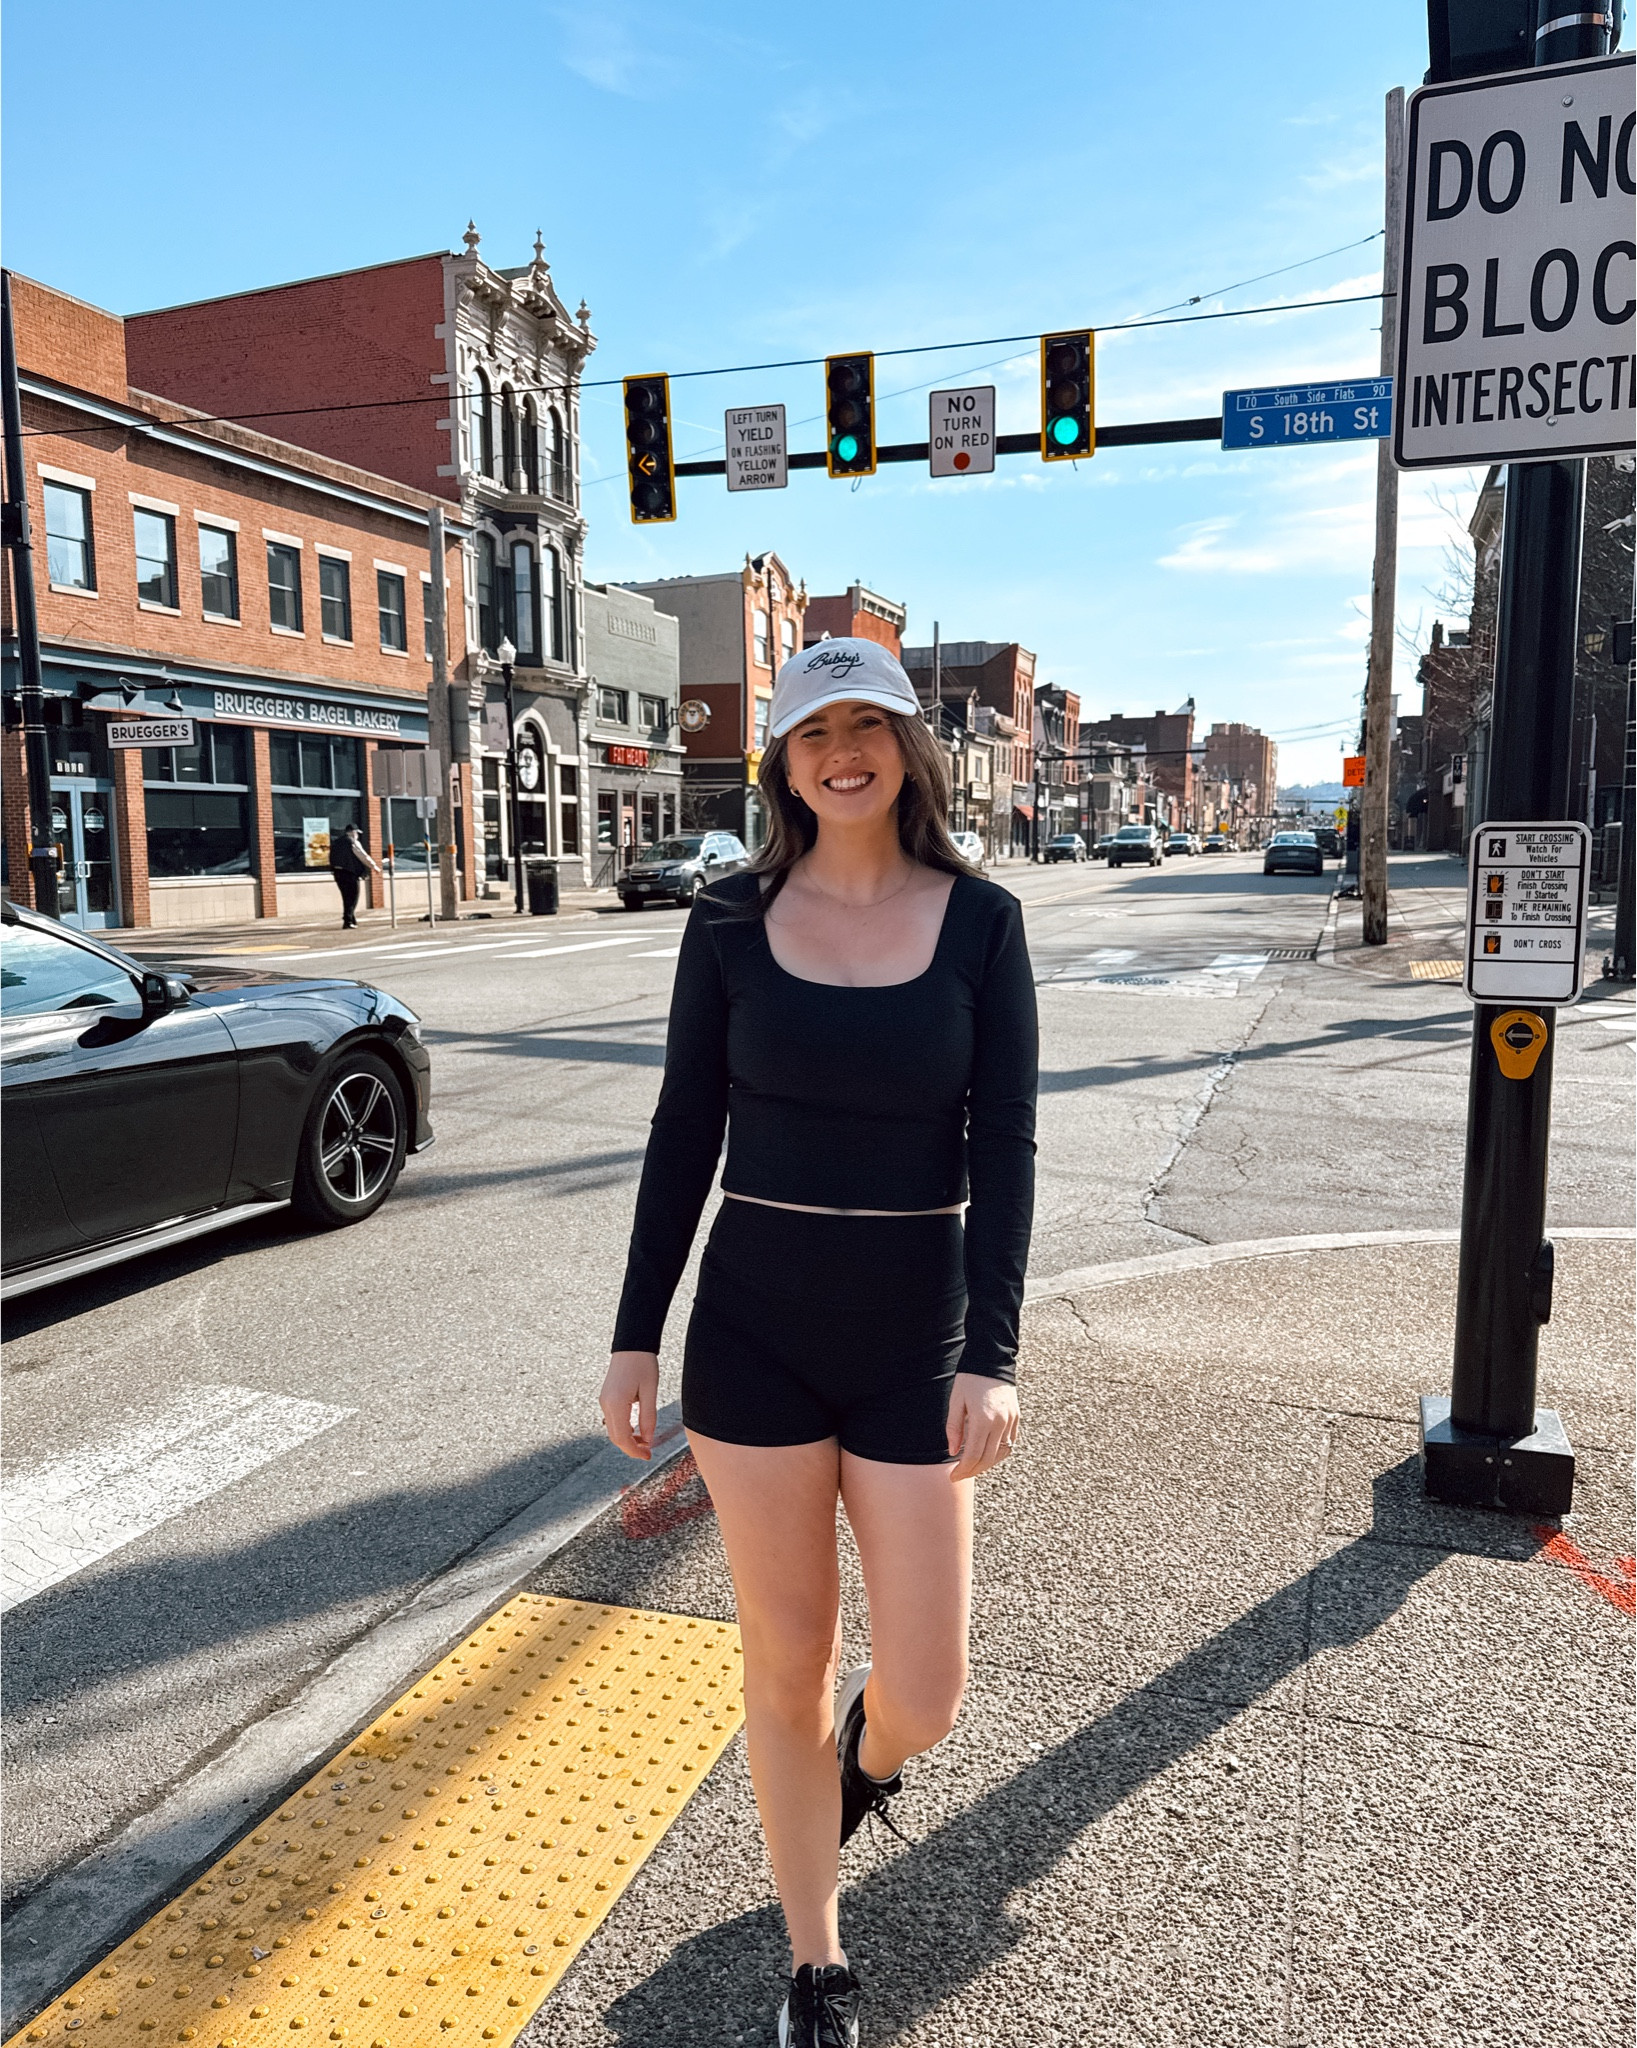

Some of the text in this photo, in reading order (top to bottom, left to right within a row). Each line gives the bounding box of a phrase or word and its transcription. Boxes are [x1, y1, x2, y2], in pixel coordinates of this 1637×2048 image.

[1427, 130, 1526, 222] DO
[1423, 240, 1636, 345] BLOC
[1245, 385, 1385, 408] 70 South Side Flats 90
[948, 395, 976, 413] NO
[732, 411, 778, 425] LEFT TURN
[943, 416, 981, 432] TURN
[1249, 406, 1379, 439] S 18th St
[738, 427, 774, 442] YIELD
[935, 433, 989, 450] ON RED
[731, 444, 782, 458] ON FLASHING
[737, 458, 777, 472] YELLOW
[739, 473, 776, 485] ARROW
[803, 652, 865, 679] Bubby's
[214, 691, 401, 731] BRUEGGER'S BAGEL BAKERY
[112, 724, 189, 739] BRUEGGER'S
[1516, 834, 1574, 843] START CROSSING
[1526, 845, 1562, 853] Watch For
[1529, 854, 1558, 863] Vehicles
[1521, 870, 1565, 879] DON'T START
[1517, 881, 1568, 892] Finish Crossing
[1526, 891, 1558, 899] If Started
[1512, 902, 1572, 912] TIME REMAINING
[1511, 913, 1572, 924] To Finish Crossing
[1513, 939, 1562, 949] DON'T CROSS
